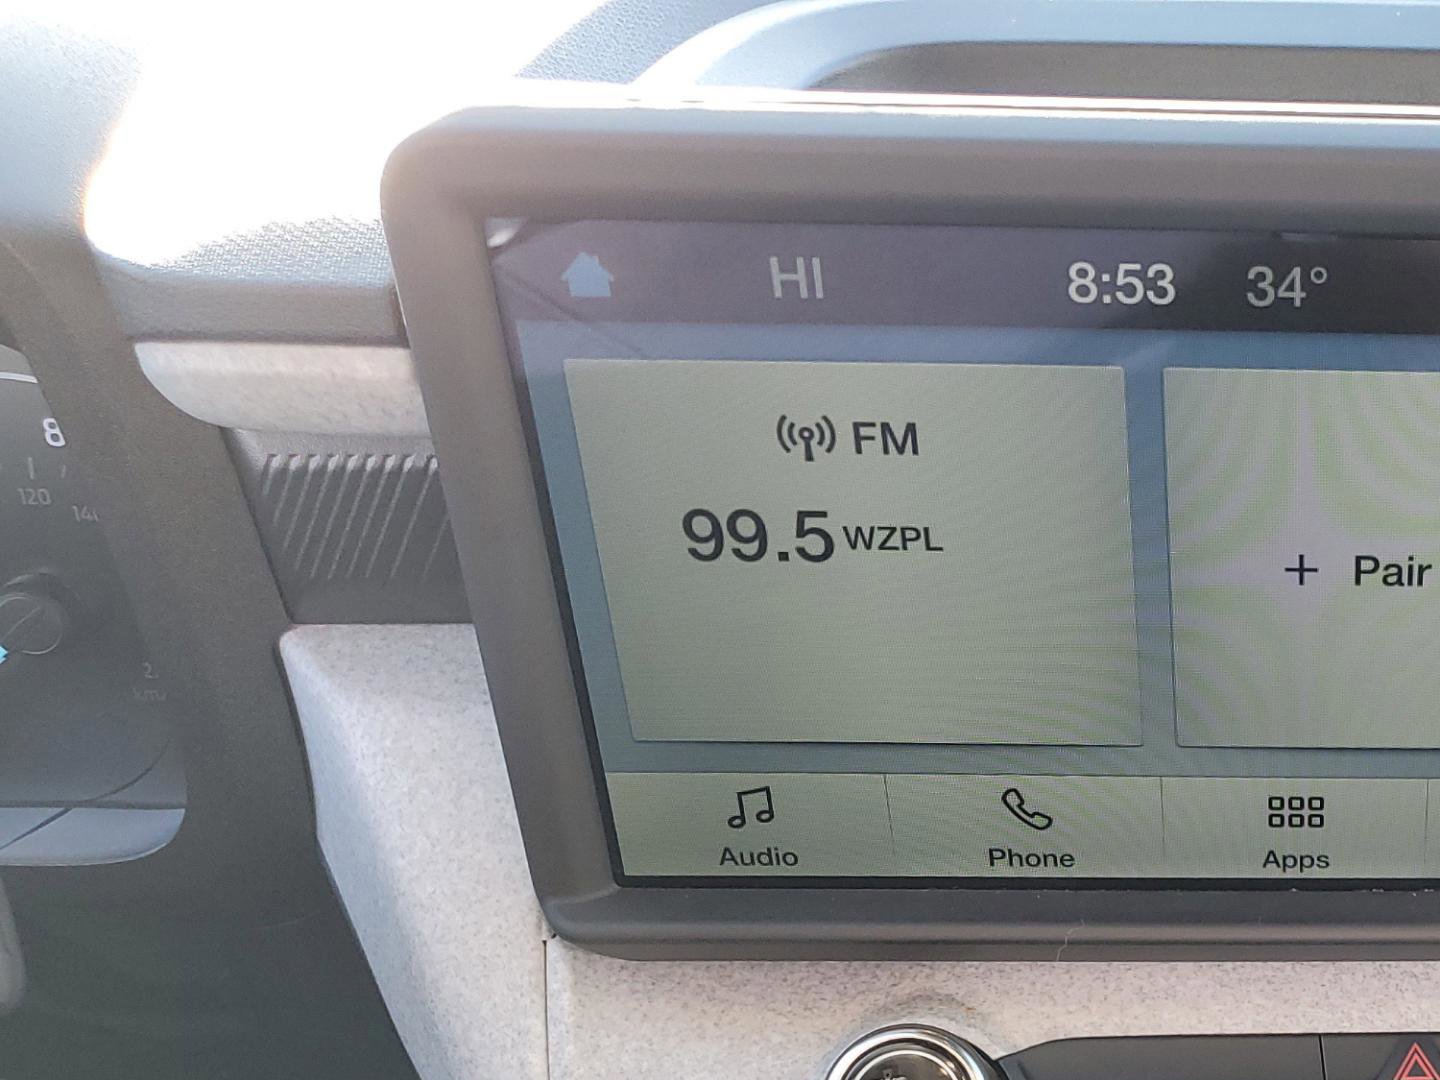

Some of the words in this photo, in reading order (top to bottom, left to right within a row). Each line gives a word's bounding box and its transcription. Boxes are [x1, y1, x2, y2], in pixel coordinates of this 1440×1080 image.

[769, 256, 825, 299] HI
[1066, 261, 1177, 305] 8:53
[1245, 266, 1329, 307] 34°
[851, 421, 919, 456] FM
[17, 487, 52, 505] 120
[681, 508, 835, 563] 99.5
[842, 525, 943, 551] WZPL
[1353, 555, 1432, 586] Pair
[718, 847, 799, 867] Audio
[987, 847, 1076, 868] Phone
[1262, 849, 1330, 872] Apps
